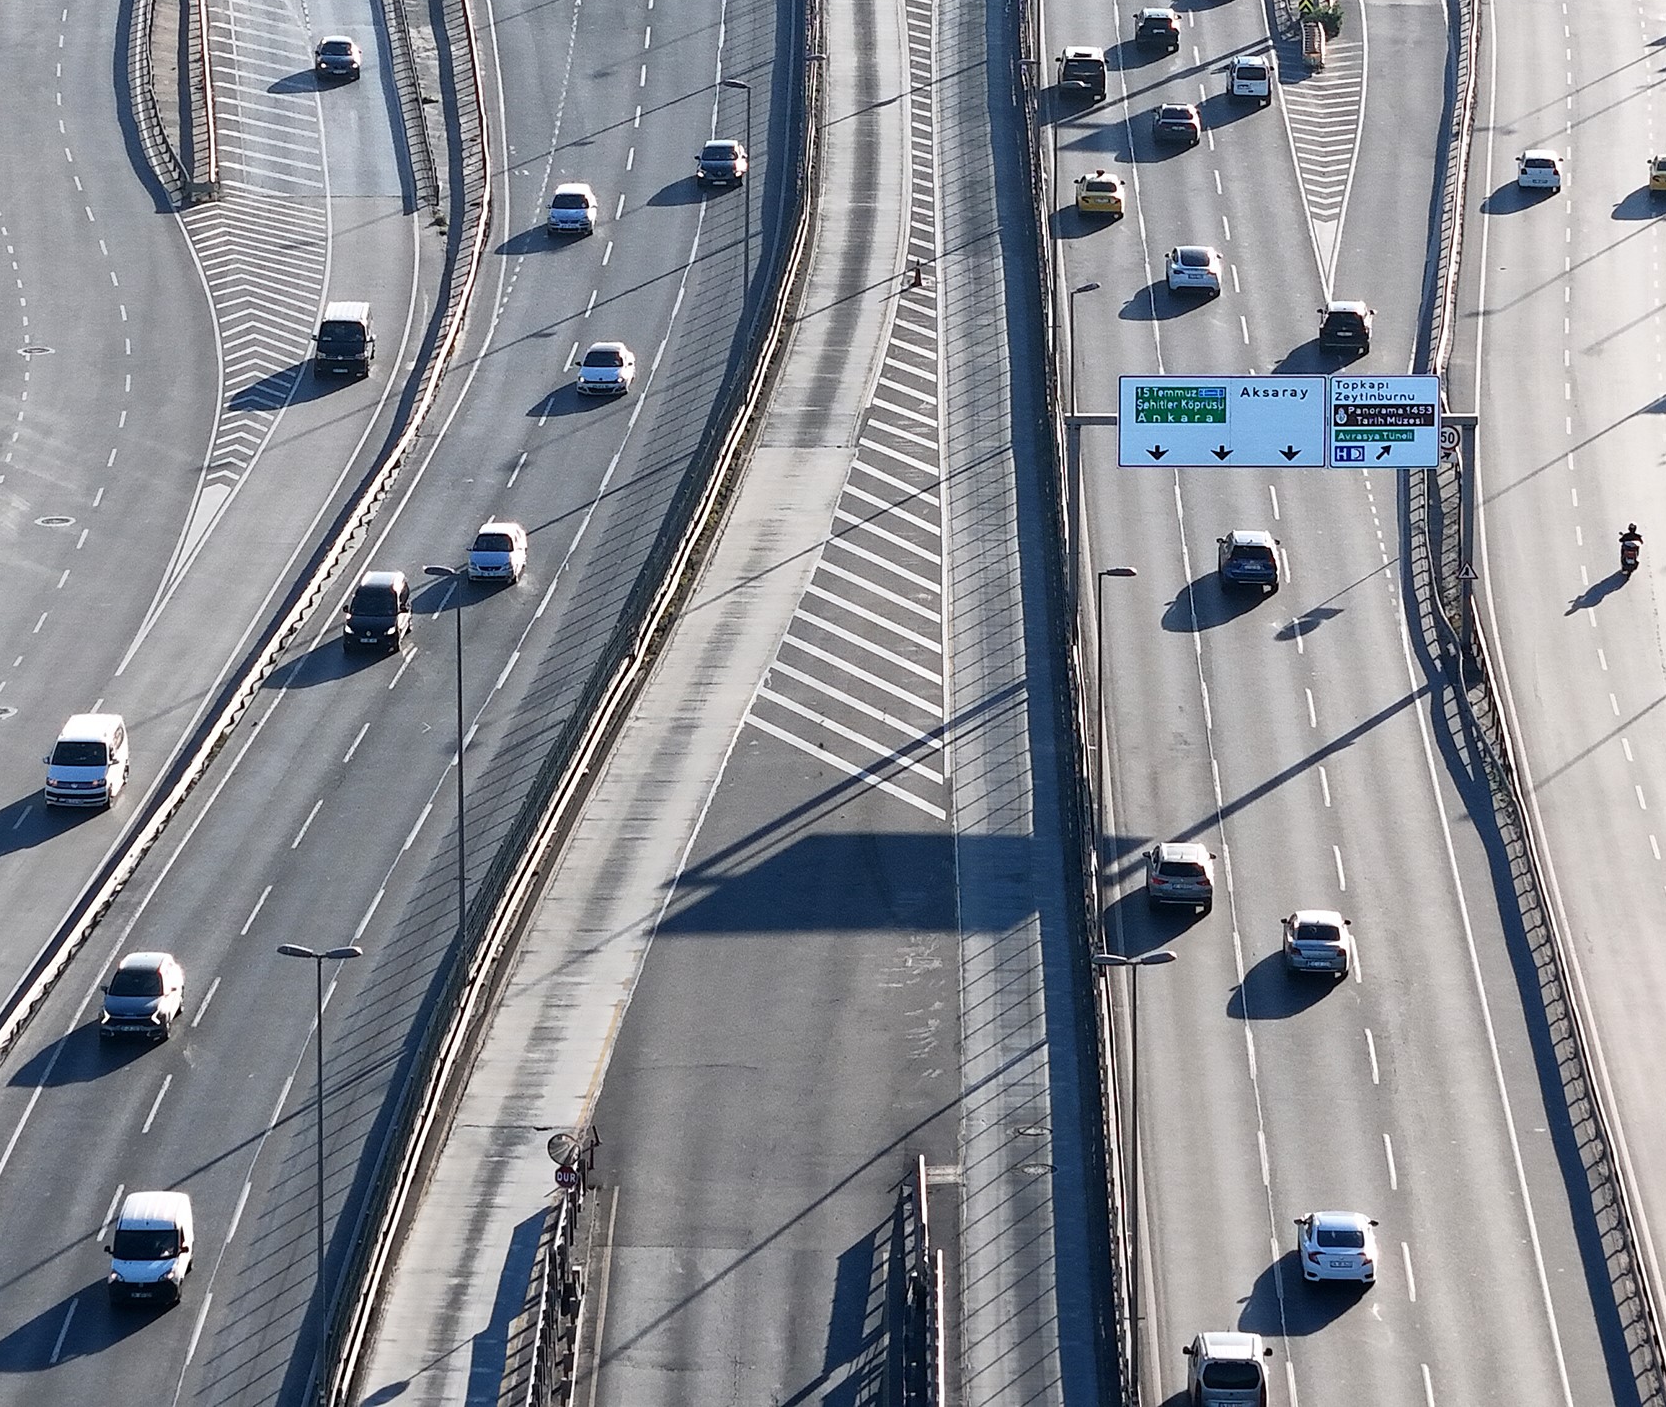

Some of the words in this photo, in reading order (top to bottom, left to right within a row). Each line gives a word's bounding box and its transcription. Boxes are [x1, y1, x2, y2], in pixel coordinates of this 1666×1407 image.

[1334, 380, 1390, 393] Topkapı
[1136, 387, 1151, 398] 15
[1152, 388, 1197, 398] Temmuz
[1239, 386, 1310, 401] Aksaray
[1334, 391, 1416, 403] Zeytinburnu
[1136, 398, 1179, 412] Şehitler
[1181, 397, 1225, 412] Köprüsü
[1137, 411, 1215, 423] Ankara
[1348, 406, 1405, 416] Panorama
[1406, 406, 1433, 416] 1453
[1356, 416, 1385, 426] Tarih
[1387, 416, 1424, 426] Müzesi
[1337, 431, 1380, 442] Avrasya
[1381, 430, 1414, 441] Tüneli
[1440, 430, 1454, 445] 50
[1336, 448, 1348, 461] H
[556, 1173, 576, 1183] DUR
